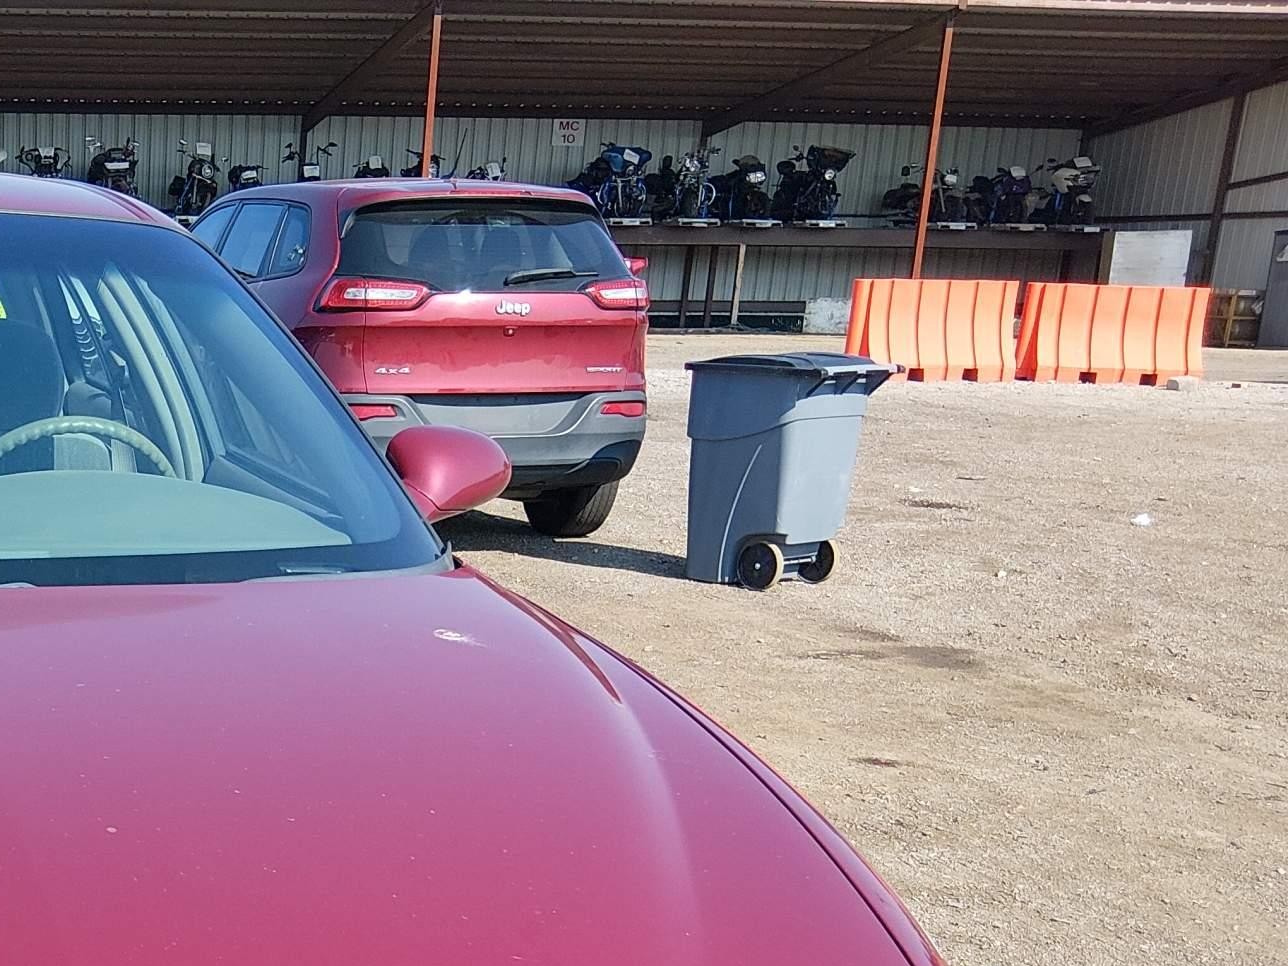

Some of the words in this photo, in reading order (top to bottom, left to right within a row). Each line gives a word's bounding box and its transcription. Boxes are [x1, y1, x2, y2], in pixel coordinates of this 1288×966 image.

[559, 120, 580, 131] MC
[561, 133, 576, 144] 10
[495, 299, 531, 316] Jeep
